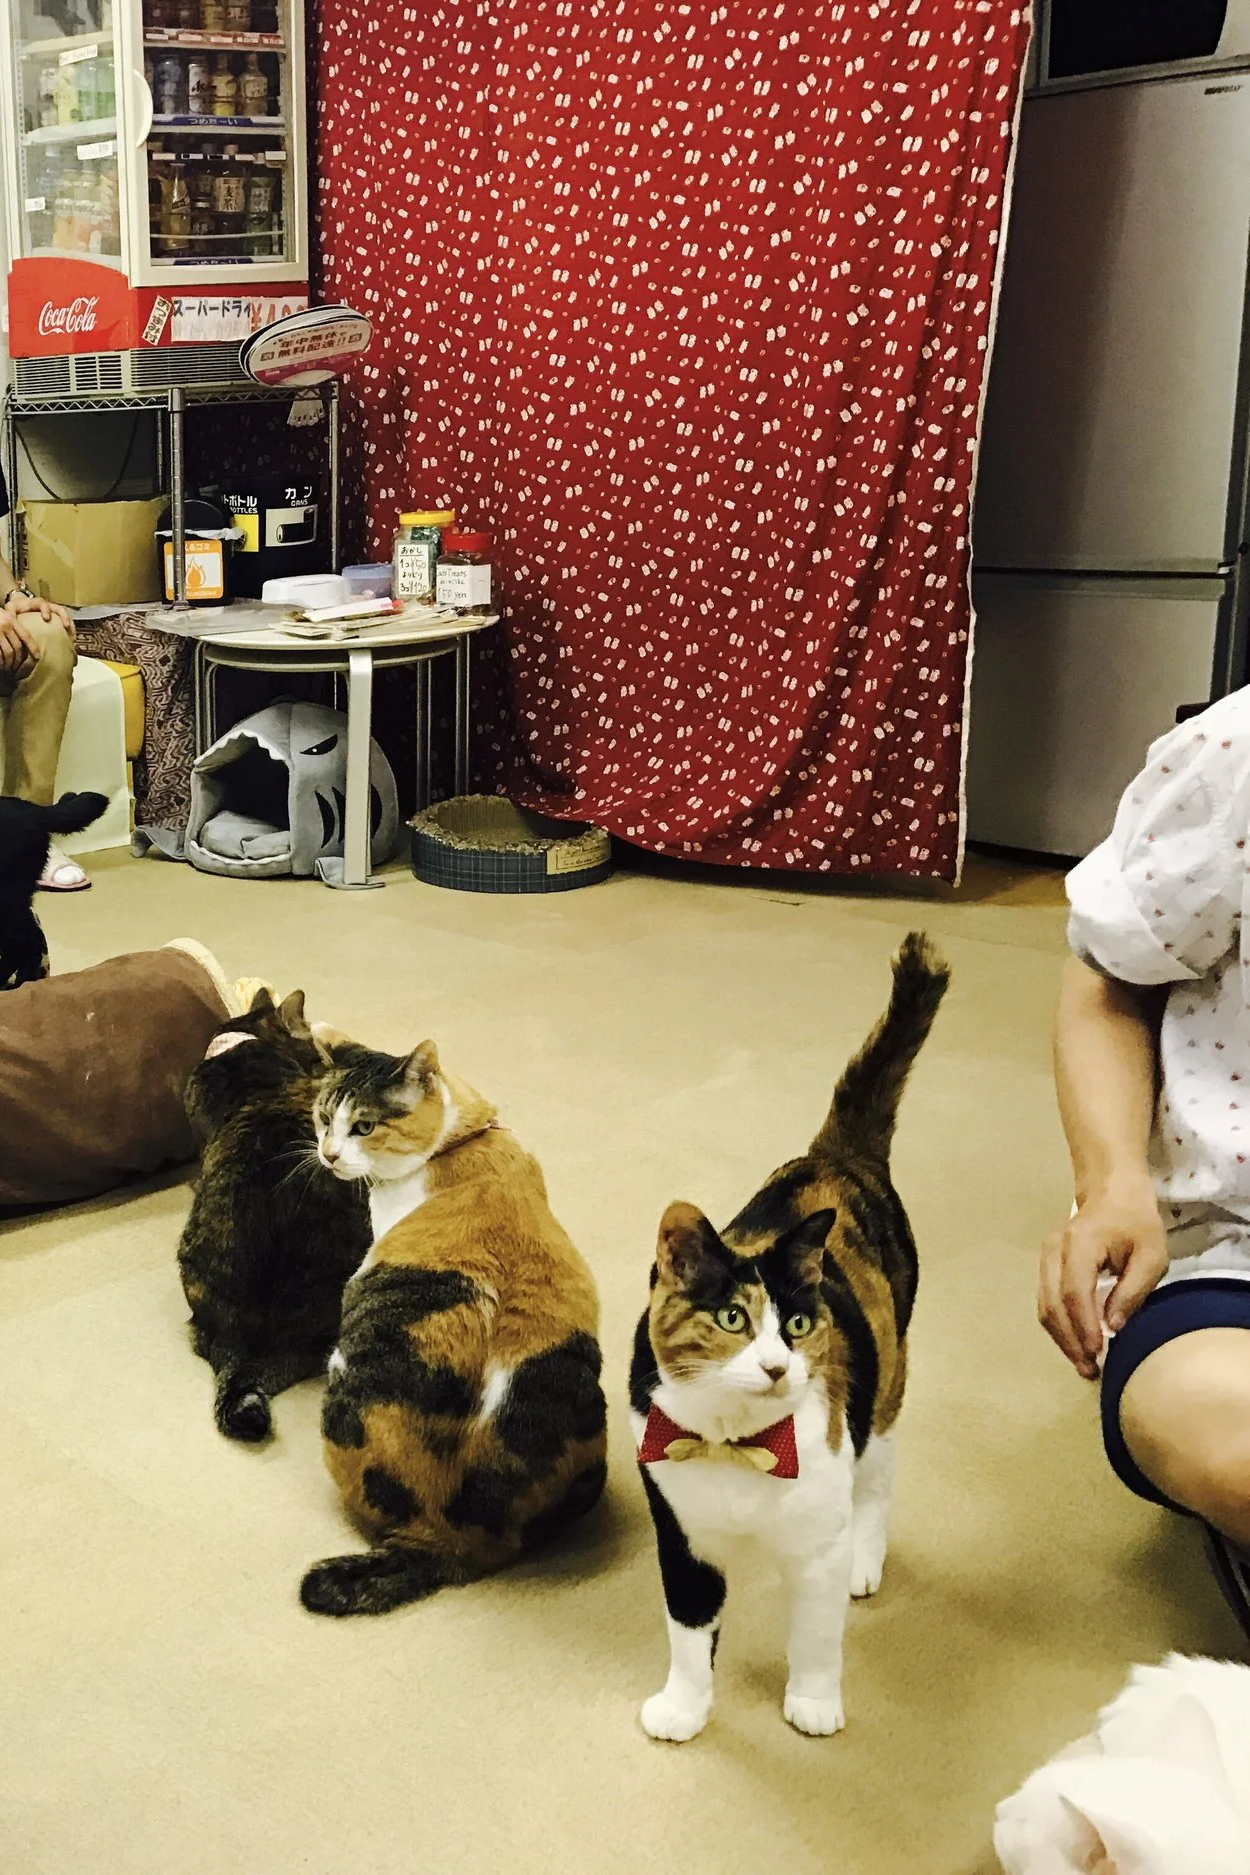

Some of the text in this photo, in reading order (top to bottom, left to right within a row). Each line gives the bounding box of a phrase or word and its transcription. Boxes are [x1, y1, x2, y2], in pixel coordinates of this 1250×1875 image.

[173, 300, 251, 318] スーパードライ
[38, 296, 100, 336] Coca-Cola
[291, 499, 308, 507] CANS
[401, 546, 423, 555] おかし
[454, 591, 467, 600] yen
